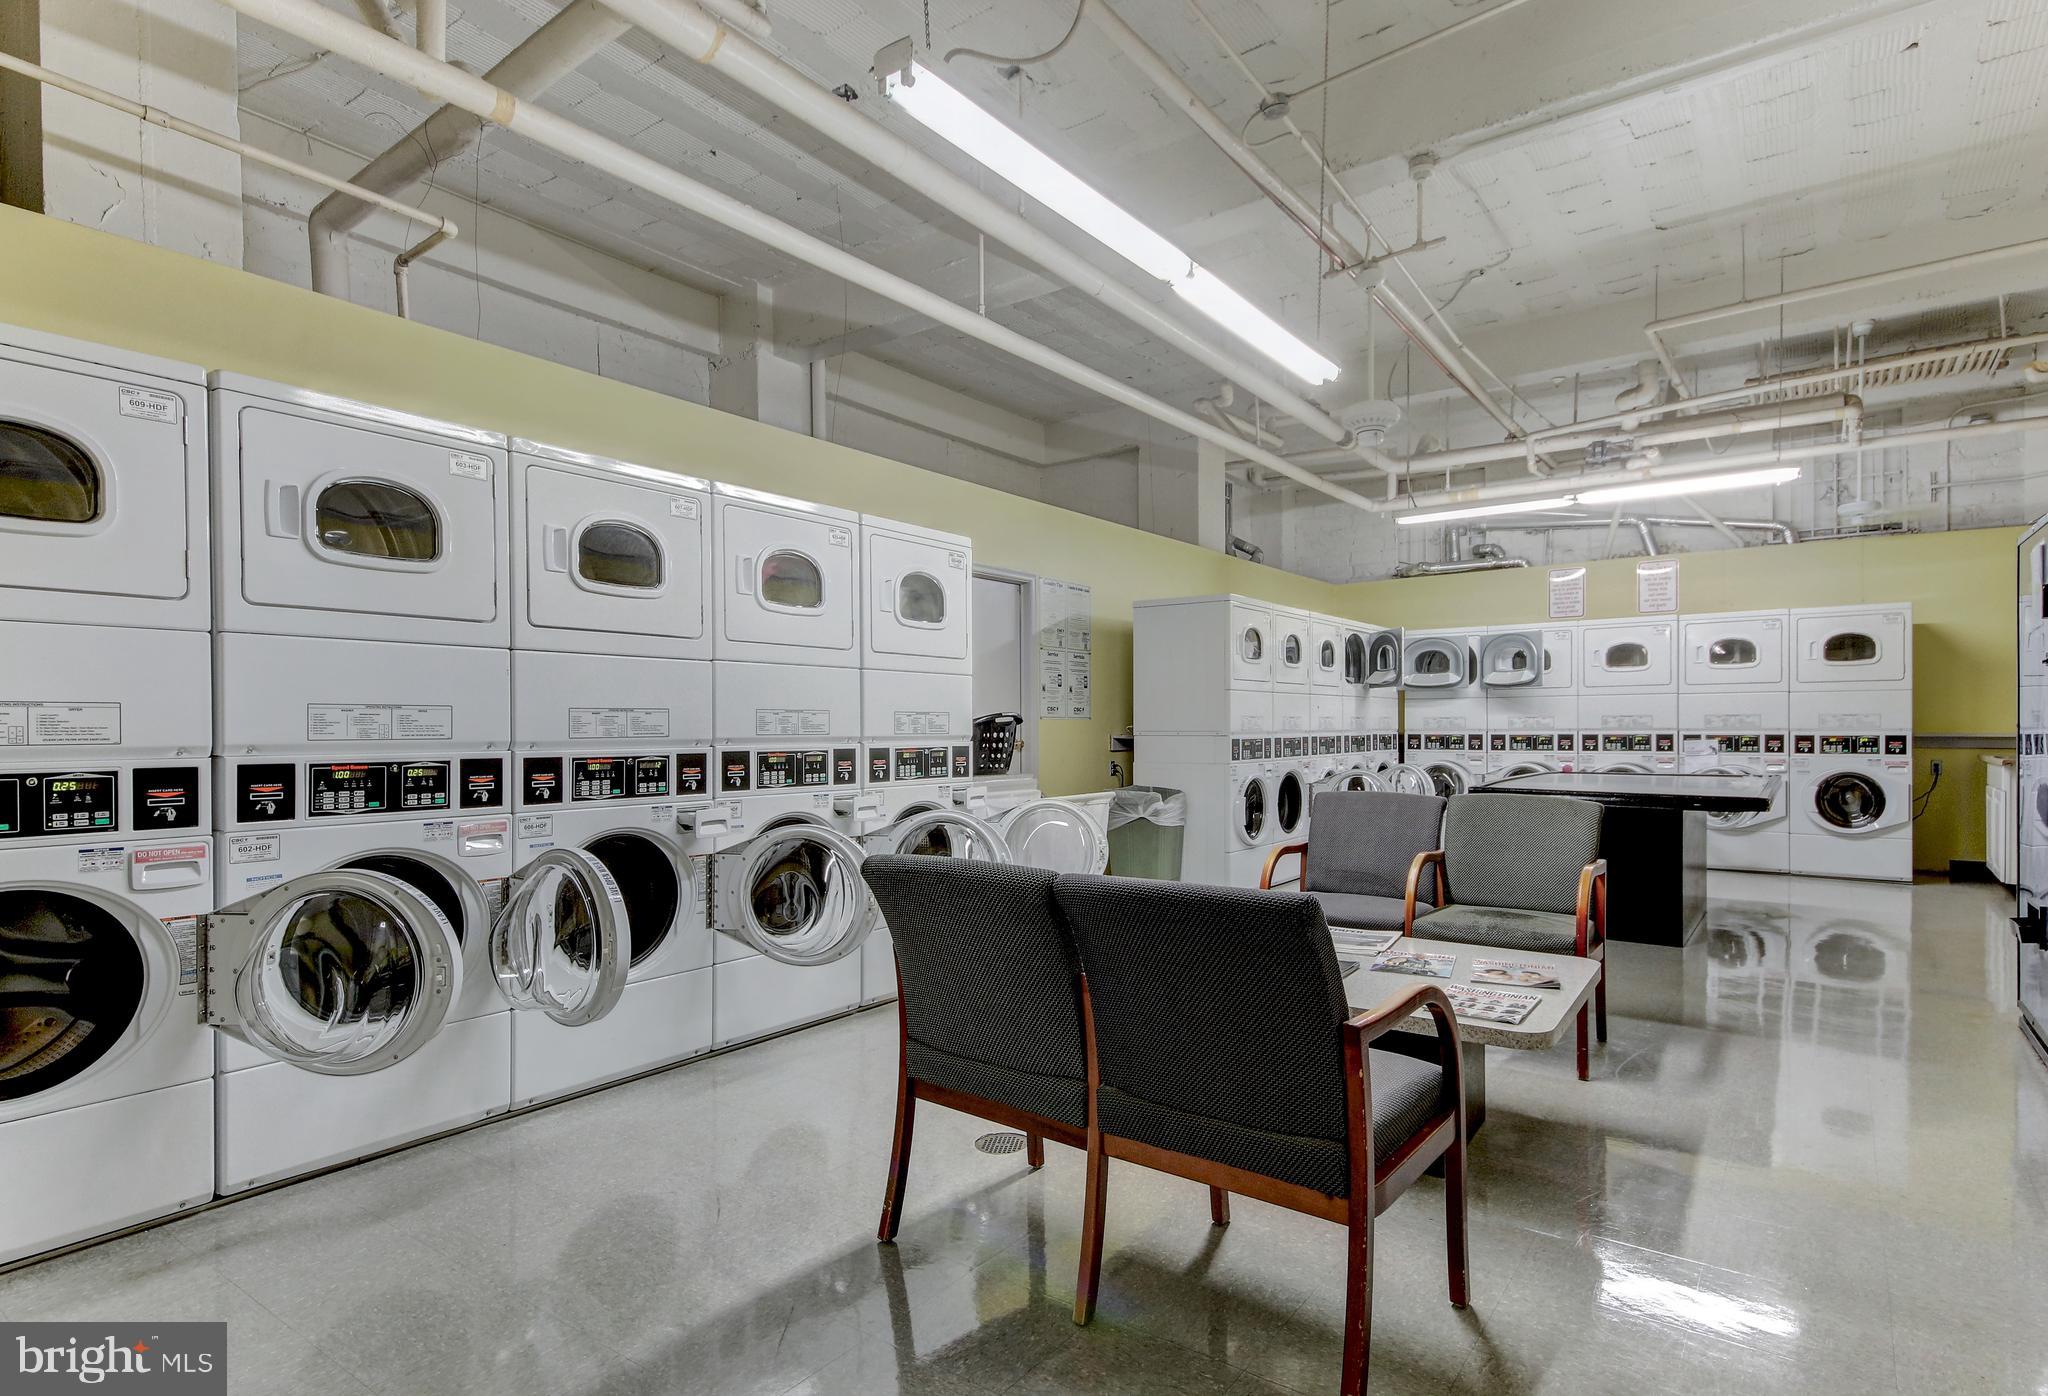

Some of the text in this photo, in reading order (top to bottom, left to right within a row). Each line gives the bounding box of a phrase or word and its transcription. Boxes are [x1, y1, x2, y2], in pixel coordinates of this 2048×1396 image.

[129, 400, 168, 411] 609-HDF
[52, 781, 77, 791] 0.25
[163, 848, 181, 856] OPEN
[238, 844, 272, 852] 602-HDF
[1450, 984, 1538, 1001] WASHINGTONIAN
